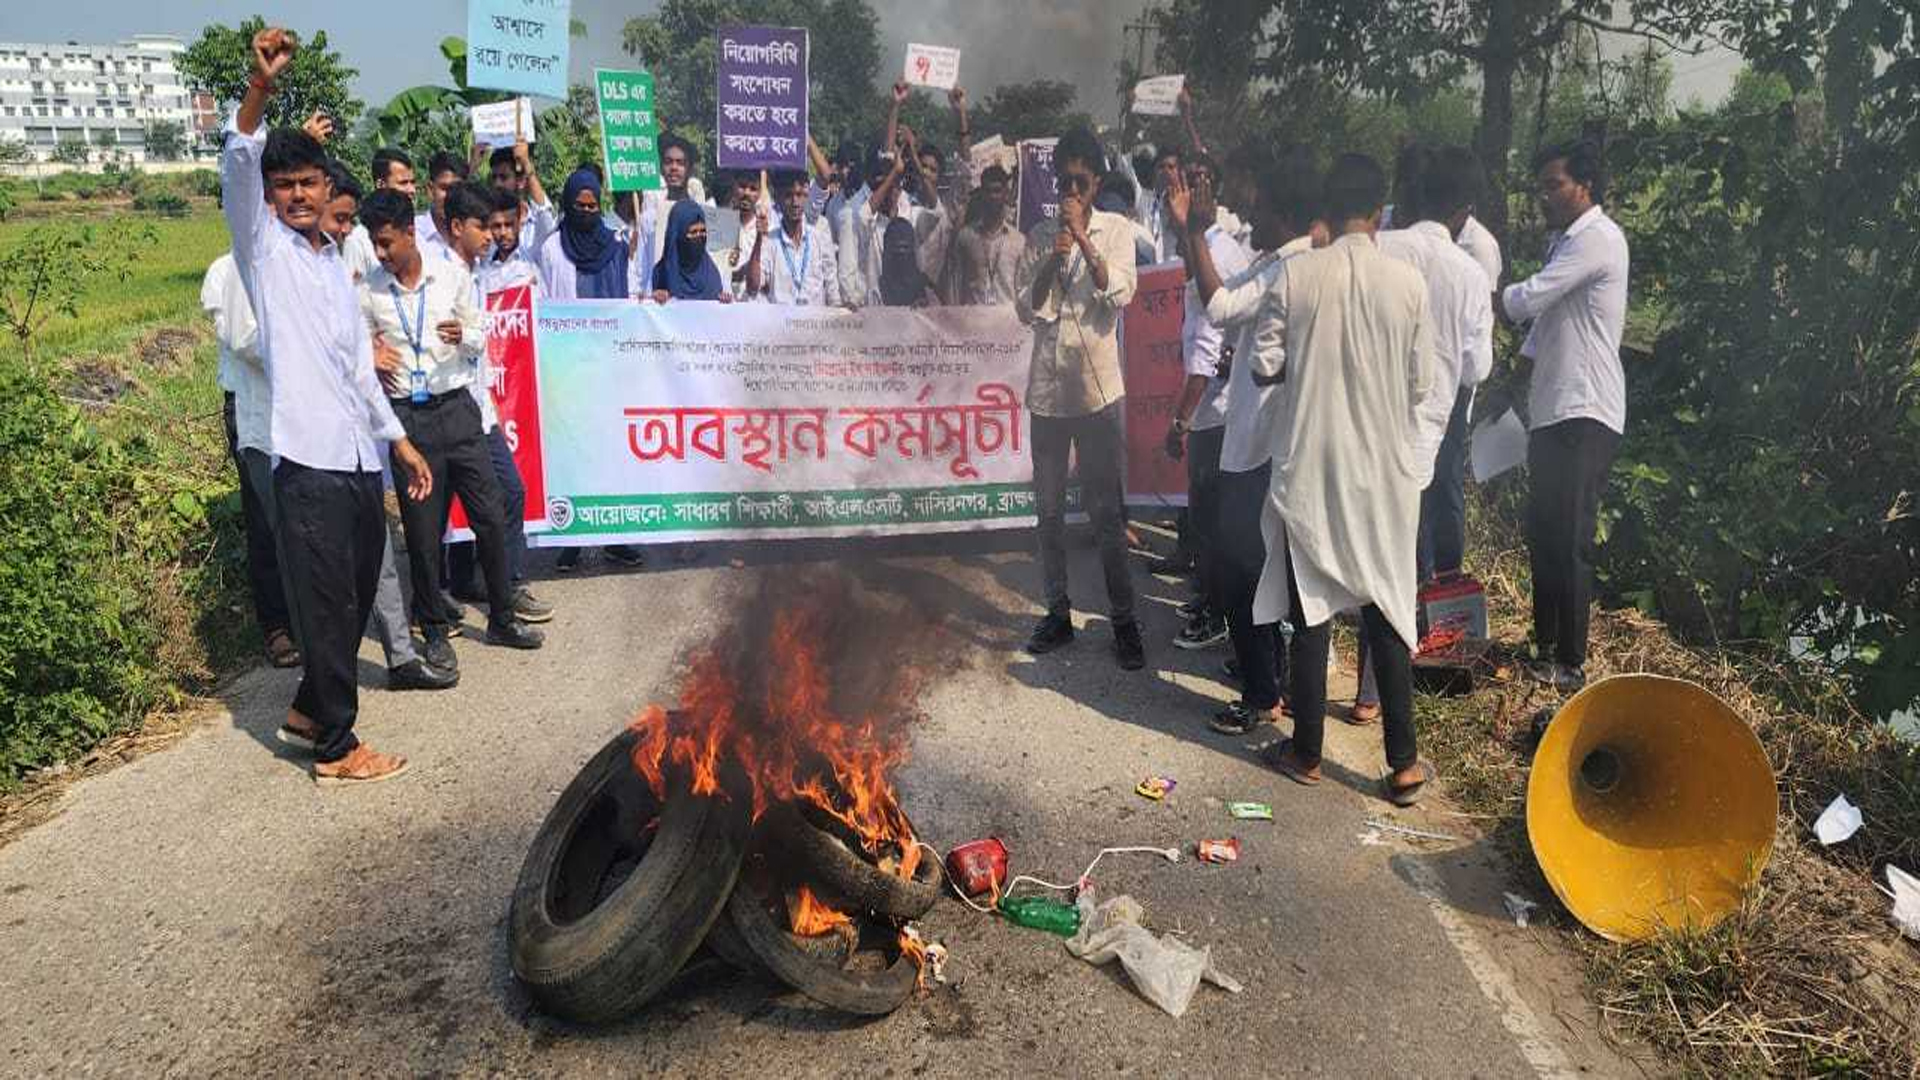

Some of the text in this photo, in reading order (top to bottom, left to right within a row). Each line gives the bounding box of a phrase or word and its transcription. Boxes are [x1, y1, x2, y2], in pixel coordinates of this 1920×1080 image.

[492, 15, 546, 39] আশ্বাসে
[474, 46, 502, 68] রয়ে
[723, 38, 798, 65] নিয়োগবিধি
[602, 81, 628, 100] DLS
[730, 75, 792, 96] সংশোধন
[722, 105, 799, 126] করতে হবে
[723, 134, 799, 156] করতে হবে
[624, 383, 1022, 478] অবস্থান কর্মসূচী
[674, 501, 732, 524] সাধারণ
